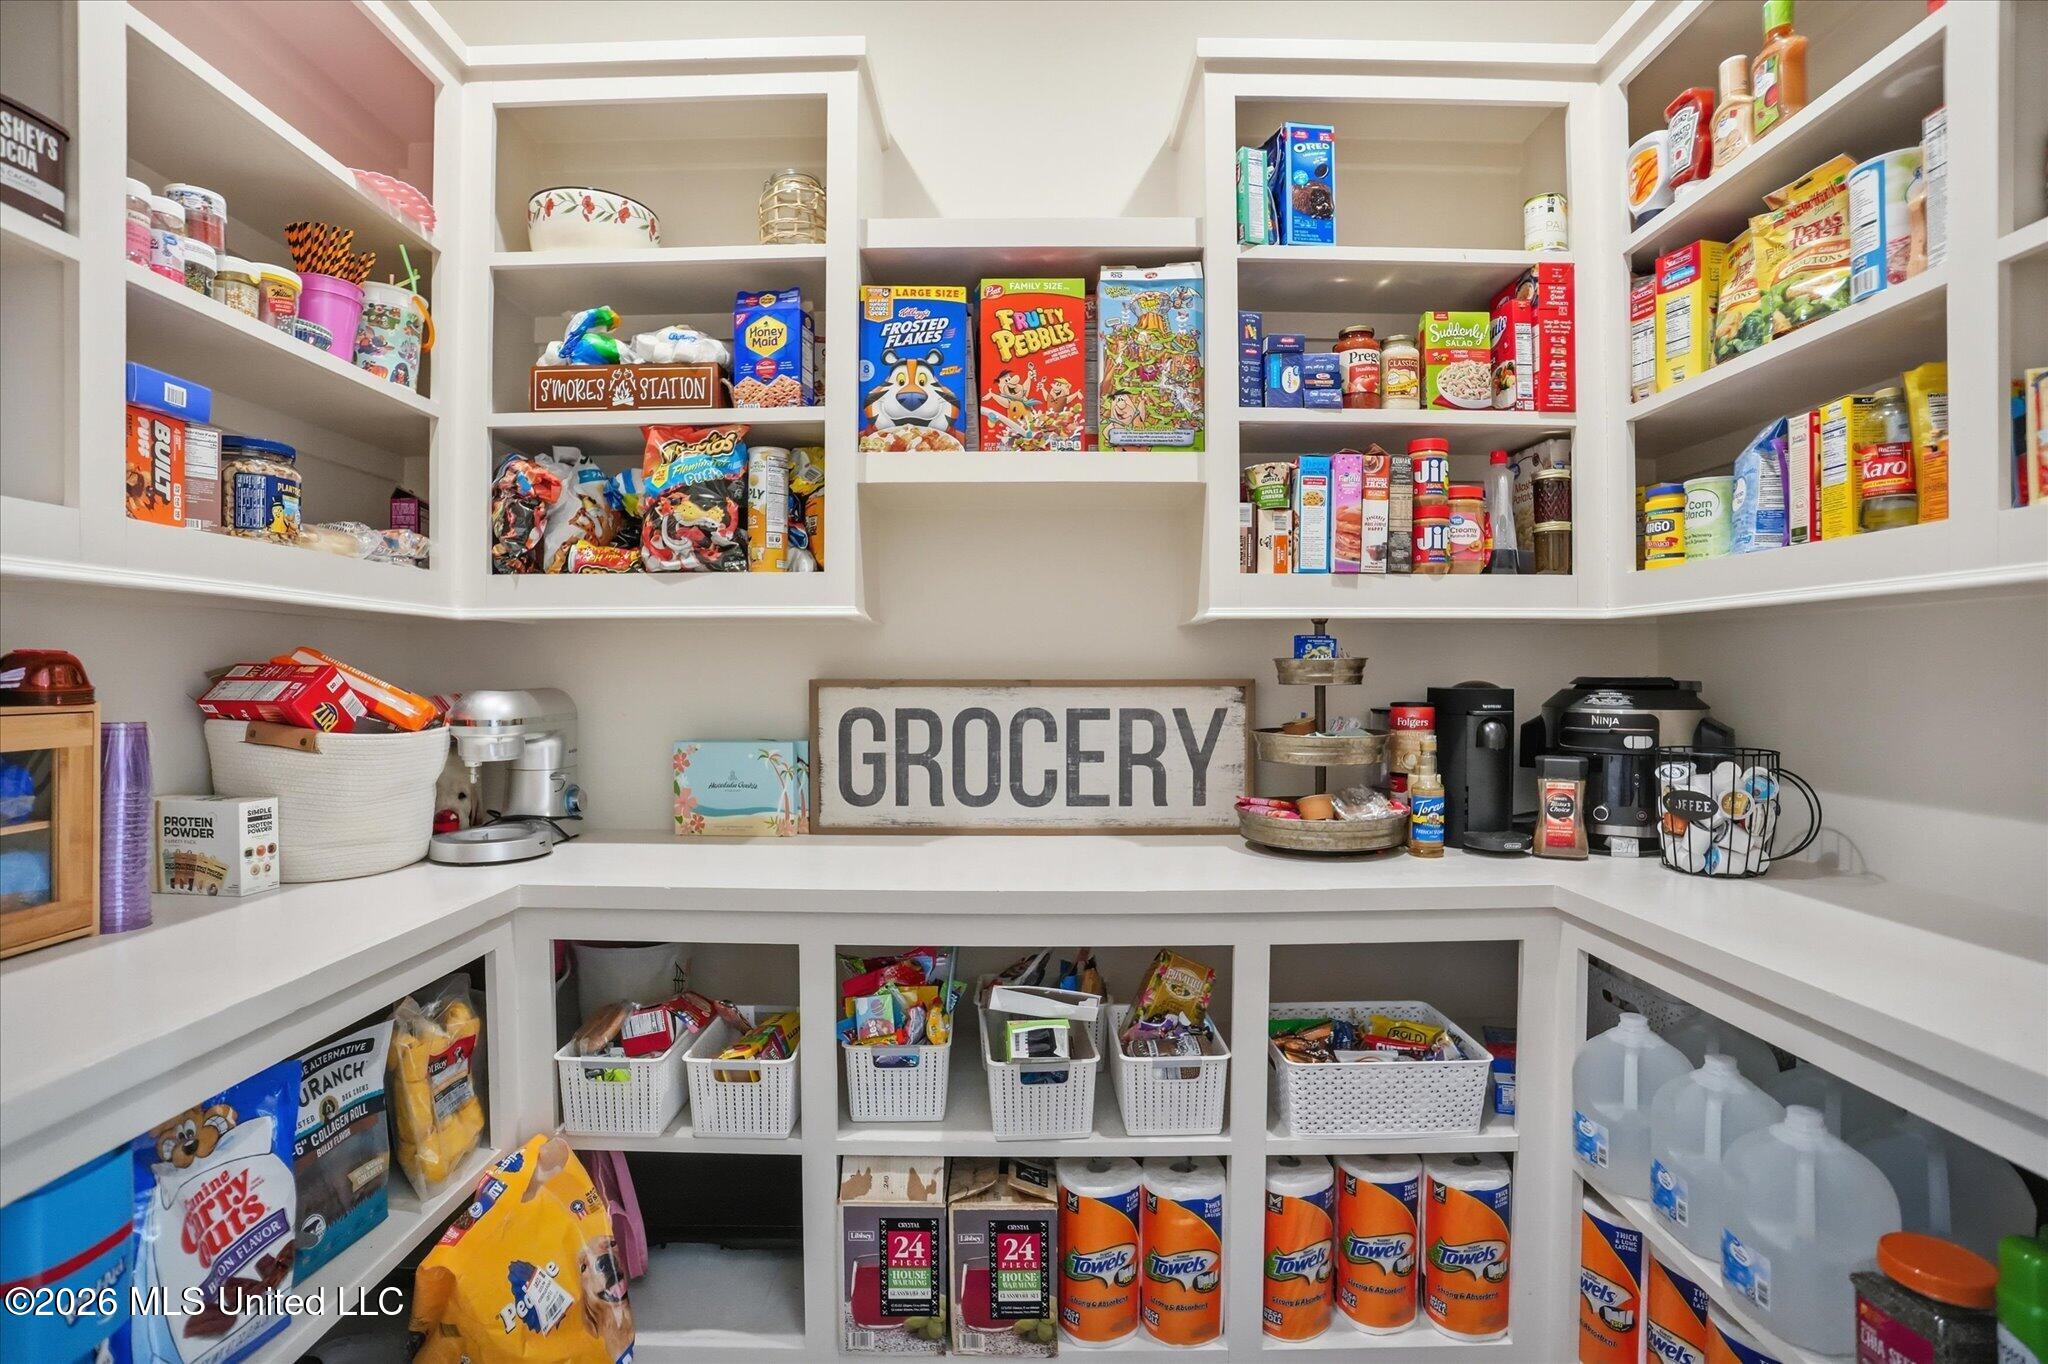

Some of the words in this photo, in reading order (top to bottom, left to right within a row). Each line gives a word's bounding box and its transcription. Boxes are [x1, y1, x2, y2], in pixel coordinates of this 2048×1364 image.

[1294, 142, 1330, 153] OREO
[896, 289, 932, 297] LARGE
[936, 290, 960, 298] SIZE
[1010, 282, 1041, 290] FAMILY
[1044, 282, 1063, 290] SIZE
[881, 318, 949, 337] FROSTED
[996, 308, 1065, 331] FRUITY
[749, 326, 784, 344] Honey
[752, 336, 778, 348] Maid
[884, 330, 943, 349] FLAKES
[991, 321, 1076, 363] PEBBLES
[1429, 322, 1490, 346] Suddenly!
[540, 377, 606, 402] S'MORES
[640, 376, 706, 400] STATION
[154, 419, 172, 503] BUILT
[1863, 460, 1907, 480] Karo
[1414, 458, 1449, 483] Jif
[1688, 500, 1712, 510] Corn
[1416, 526, 1450, 550] Jif
[1450, 526, 1478, 536] Creamy
[311, 701, 339, 733] RITZ
[1397, 717, 1429, 728] Folgers
[1591, 714, 1620, 727] NINJA
[838, 707, 1228, 808] GROCERY
[247, 806, 272, 816] SIMPLE
[1669, 798, 1712, 814] FFEE
[164, 816, 213, 828] PROTEIN
[247, 820, 273, 830] PROTEIN
[247, 826, 273, 836] POWDER
[164, 826, 215, 839] POWDER
[1392, 1029, 1422, 1043] ROLD
[309, 1041, 368, 1072] ALTERNATIVE
[310, 1111, 352, 1147] COLLAGEN
[350, 1102, 369, 1120] ROLL
[316, 1141, 334, 1158] BULLY
[334, 1126, 352, 1147] FLAVOR
[850, 1232, 873, 1240] Libbey
[1616, 1232, 1638, 1242] THICK
[1621, 1240, 1638, 1248] LONG
[894, 1234, 925, 1259] 24
[1003, 1236, 1034, 1261] 24
[1348, 1236, 1406, 1258] Towels
[1438, 1246, 1498, 1265] Towels
[1614, 1244, 1638, 1252] LASTING
[208, 1258, 235, 1296] BON
[236, 1220, 282, 1260] FLAVOR
[1072, 1251, 1128, 1275] Towels
[1152, 1256, 1208, 1276] Towels
[1274, 1247, 1325, 1275] Towels
[892, 1270, 926, 1280] HOUSE
[1002, 1272, 1038, 1282] HOUSE
[1374, 1284, 1407, 1296] Absorbent
[1466, 1291, 1498, 1302] Absorbent
[1581, 1274, 1617, 1305] wels
[1097, 1296, 1129, 1308] Absorbent
[1176, 1302, 1208, 1312] Absorbent
[1860, 1326, 1886, 1359] CHIA
